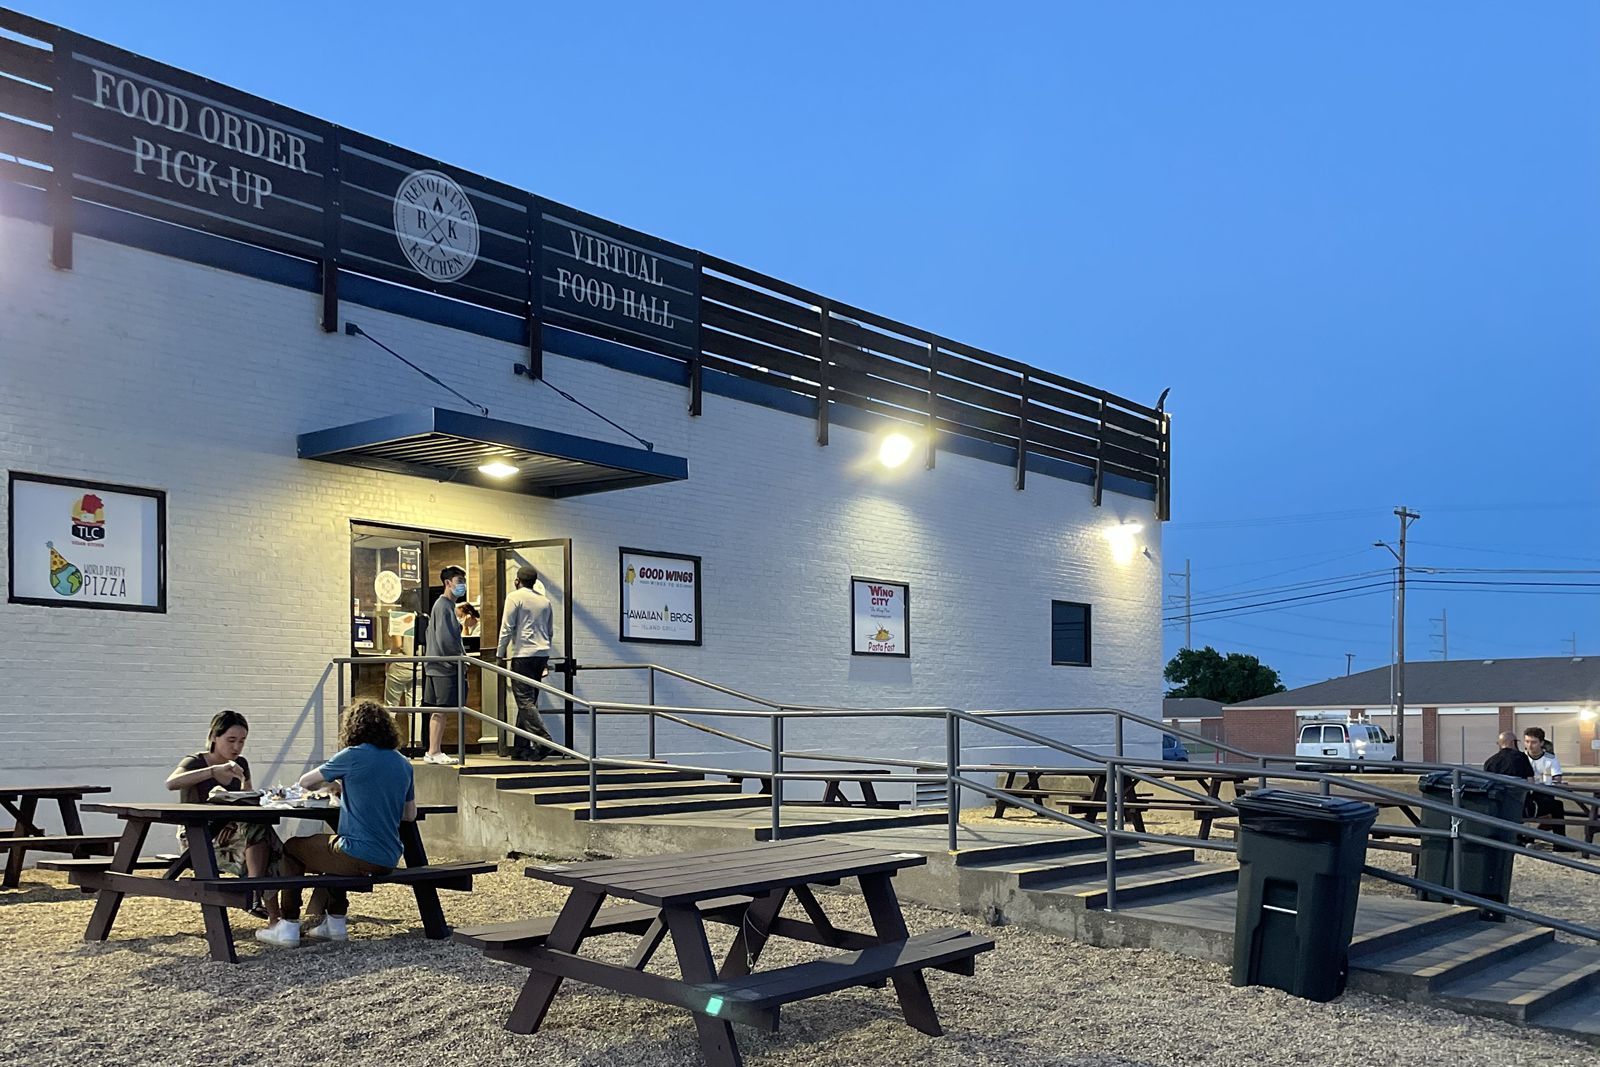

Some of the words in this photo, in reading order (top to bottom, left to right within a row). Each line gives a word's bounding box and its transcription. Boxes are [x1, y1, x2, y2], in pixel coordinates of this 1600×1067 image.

[92, 69, 189, 132] FOOD
[200, 106, 308, 173] ORDER
[132, 136, 273, 209] PICK-UP
[404, 178, 471, 221] REVOLVING
[416, 209, 428, 230] R
[448, 219, 458, 239] K
[409, 242, 464, 275] KITCHEN
[570, 230, 664, 287] VIRTUAL
[557, 267, 616, 311] FOOD
[622, 287, 674, 329] HALL
[77, 525, 100, 539] TLC
[84, 564, 104, 576] WORLD
[105, 565, 126, 578] PARTY
[639, 567, 664, 580] GOOD
[666, 570, 694, 583] WINGS
[84, 574, 127, 597] PIZZA
[871, 598, 890, 606] CITY
[624, 609, 663, 621] HAWAIIAN
[670, 612, 694, 623] BROS
[868, 641, 883, 652] Pasta
[884, 642, 896, 652] Fast
